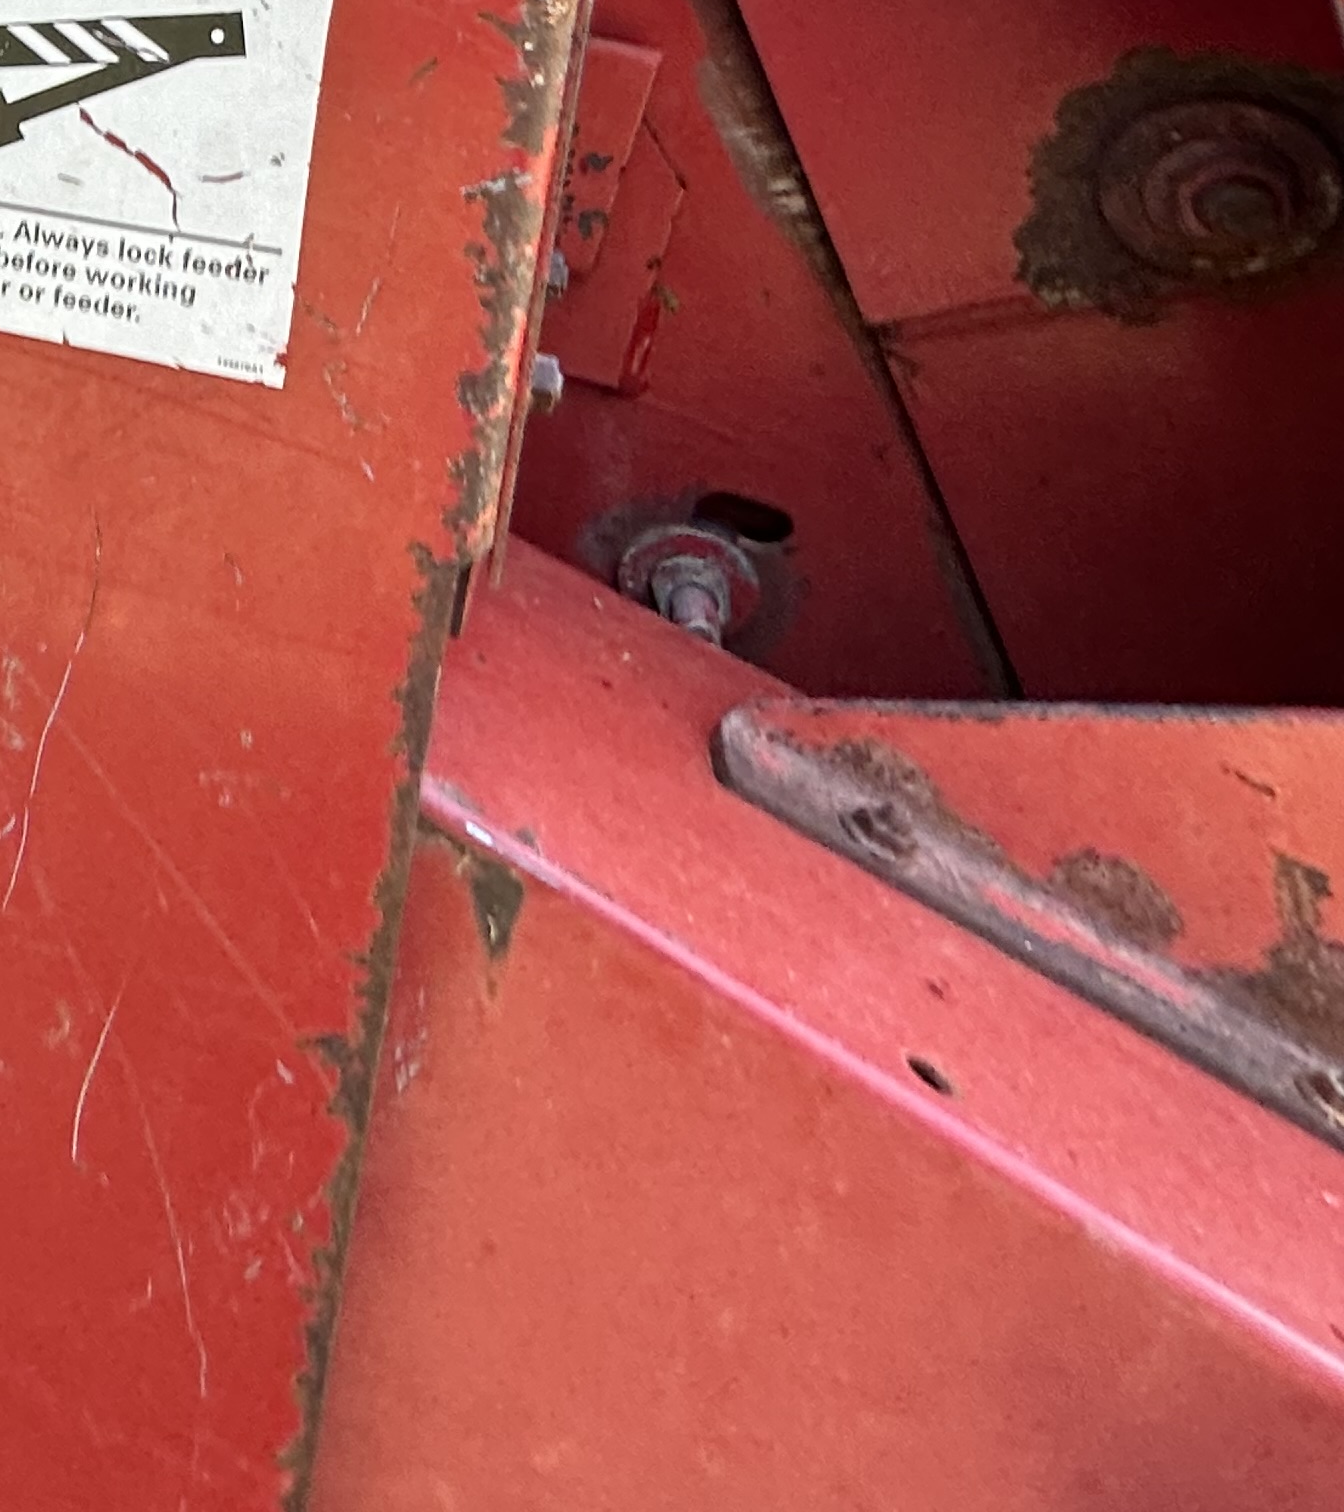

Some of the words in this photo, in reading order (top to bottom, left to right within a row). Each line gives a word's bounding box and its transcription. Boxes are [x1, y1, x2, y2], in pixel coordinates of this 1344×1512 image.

[14, 219, 110, 259] Always
[118, 237, 173, 269] lock
[183, 247, 270, 285] feeder
[19, 283, 46, 304] or
[53, 284, 141, 324] feeder.
[85, 265, 197, 308] working
